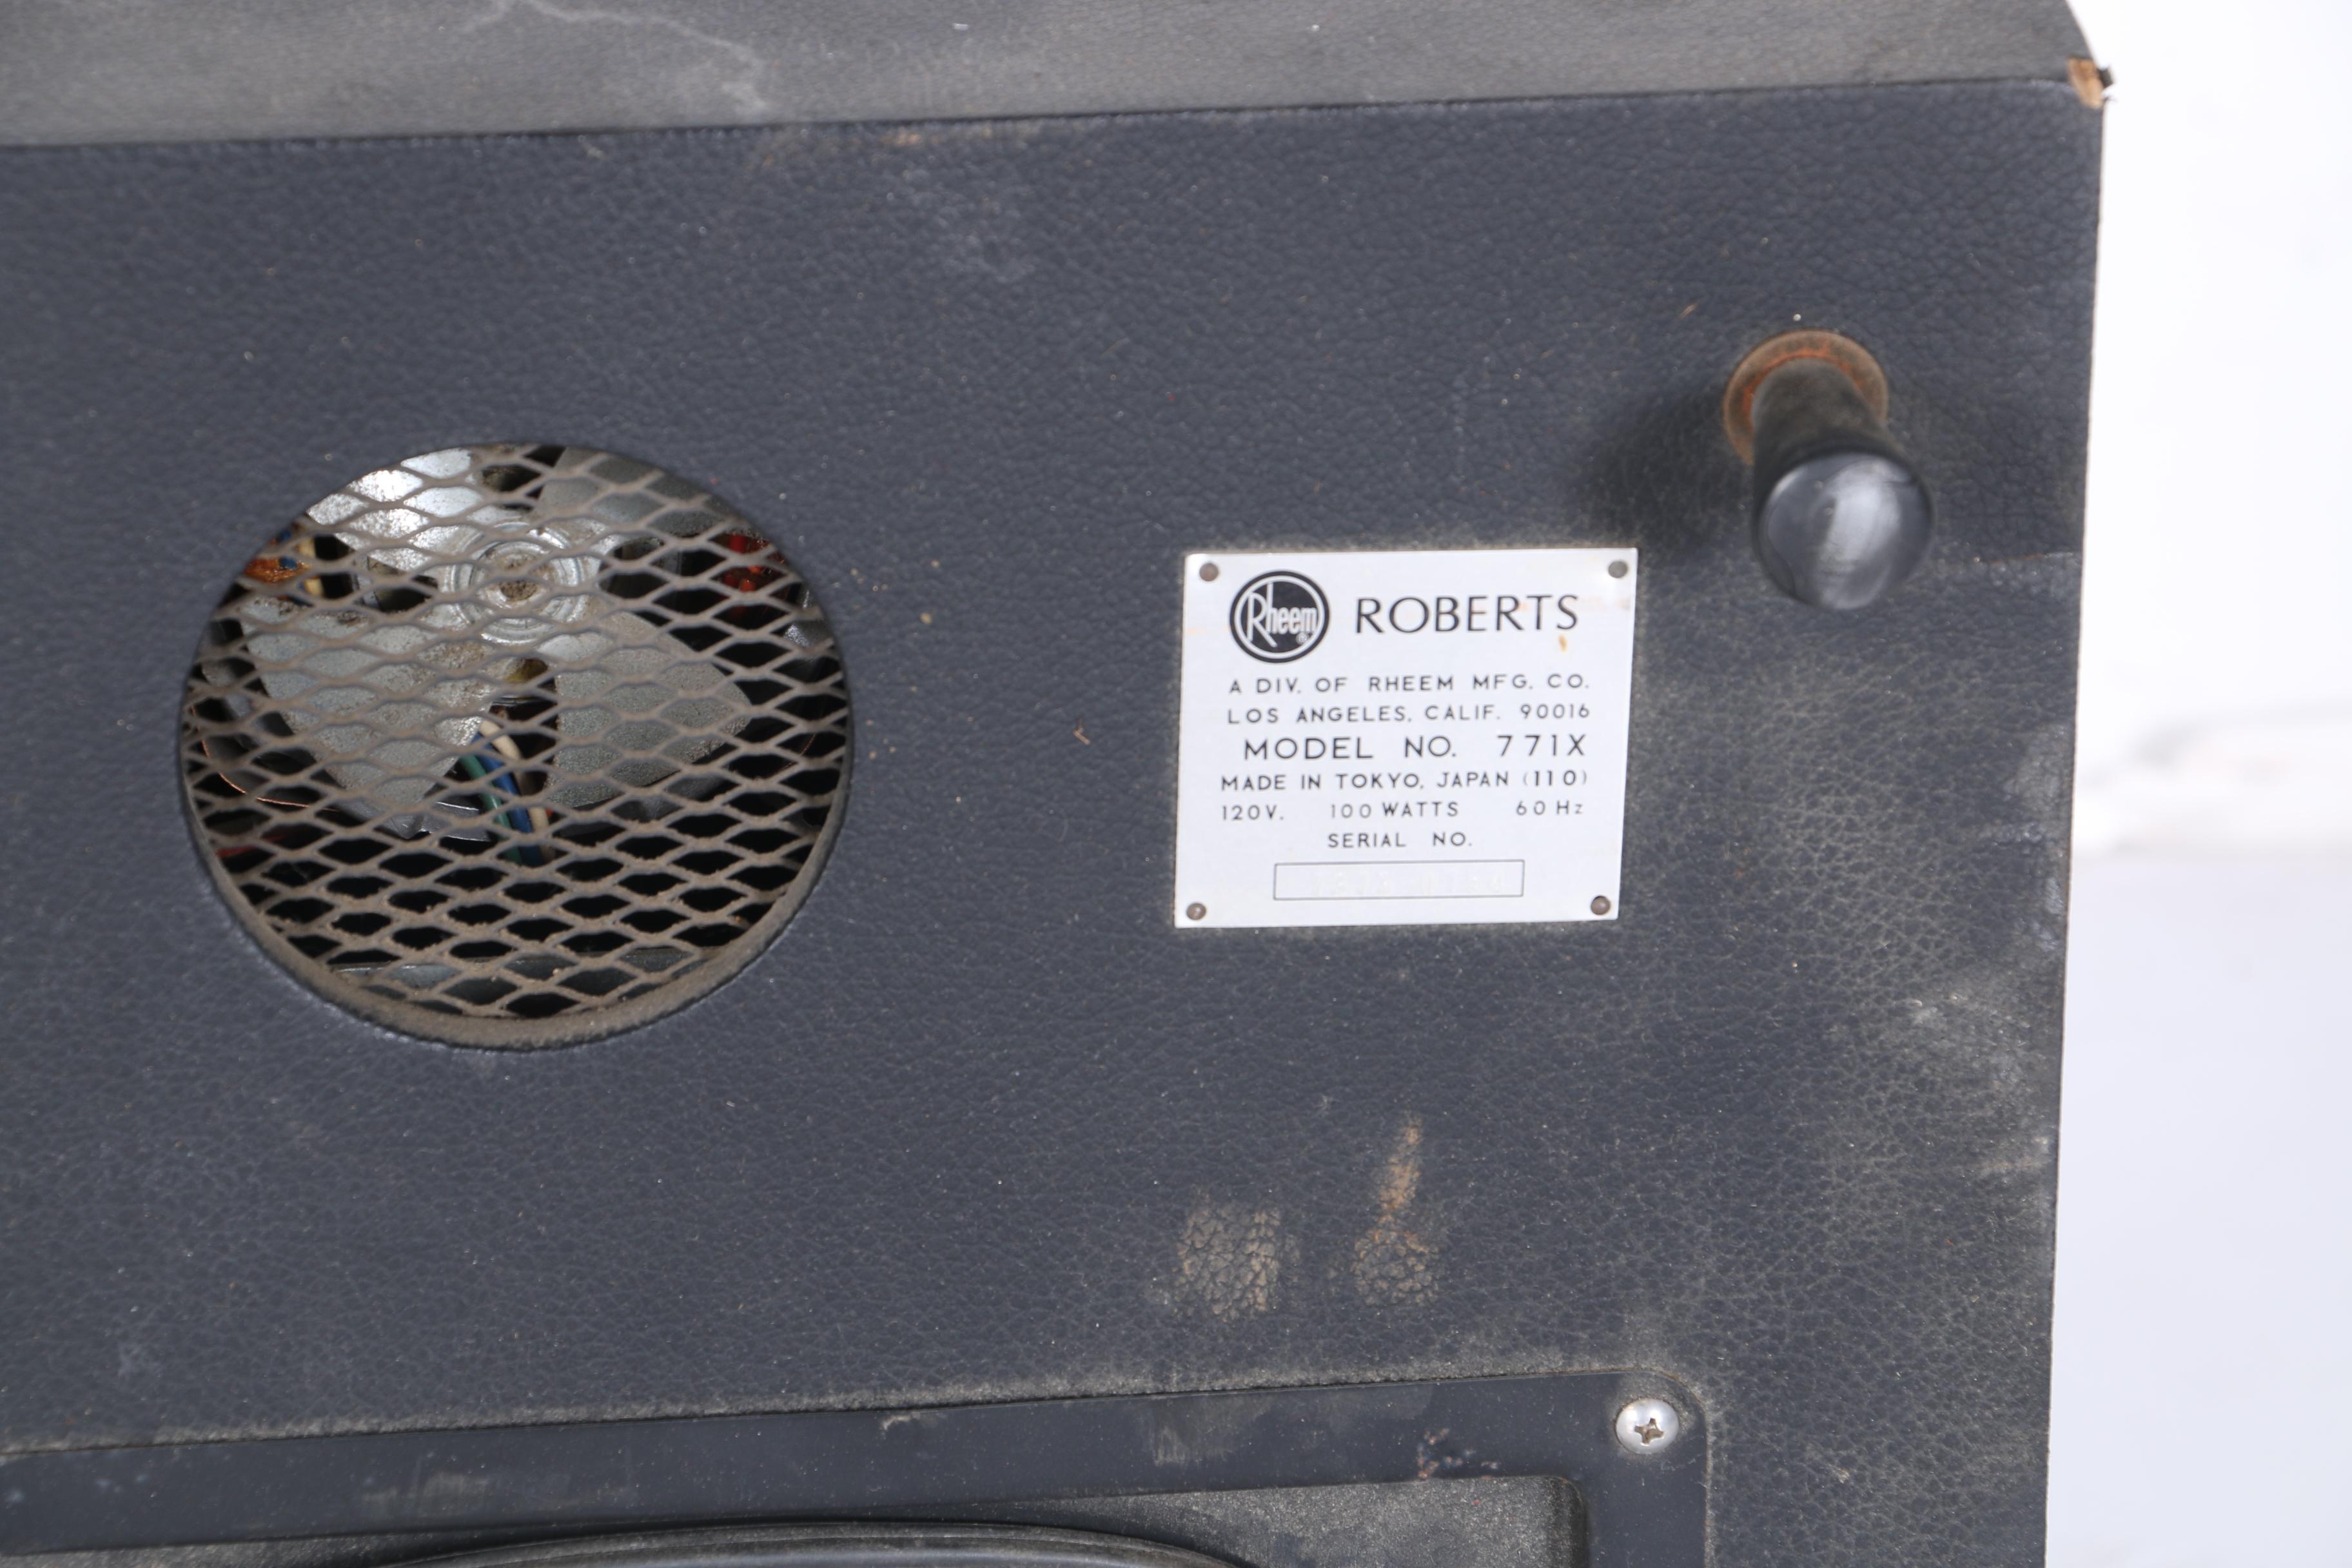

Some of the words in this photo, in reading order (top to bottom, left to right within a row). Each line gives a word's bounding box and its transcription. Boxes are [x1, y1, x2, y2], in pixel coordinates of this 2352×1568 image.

[1247, 583, 1318, 647] Rheem
[1355, 594, 1579, 634] ROBERTS
[1228, 679, 1242, 694] A
[1255, 678, 1301, 694] DIV.
[1314, 676, 1348, 693] OF
[1368, 675, 1454, 692] RHEEM
[1472, 674, 1533, 690] MFG.
[1547, 673, 1589, 689] CO.
[1227, 707, 1279, 725] LOS
[1424, 705, 1500, 721] CALIF.
[1520, 703, 1590, 720] 90016
[1243, 736, 1374, 761] MODEL
[1404, 735, 1457, 759] NO.
[1496, 734, 1586, 758] 771X
[1220, 774, 1286, 791] MADE
[1300, 774, 1321, 790] IN
[1436, 771, 1509, 788] JAPAN
[1522, 770, 1588, 787] (110)
[1222, 804, 1284, 821] 120V.
[1330, 803, 1372, 819] 100
[1382, 801, 1459, 818] WATTS
[1328, 832, 1406, 848] SERIAL
[1432, 832, 1473, 847] NO.
